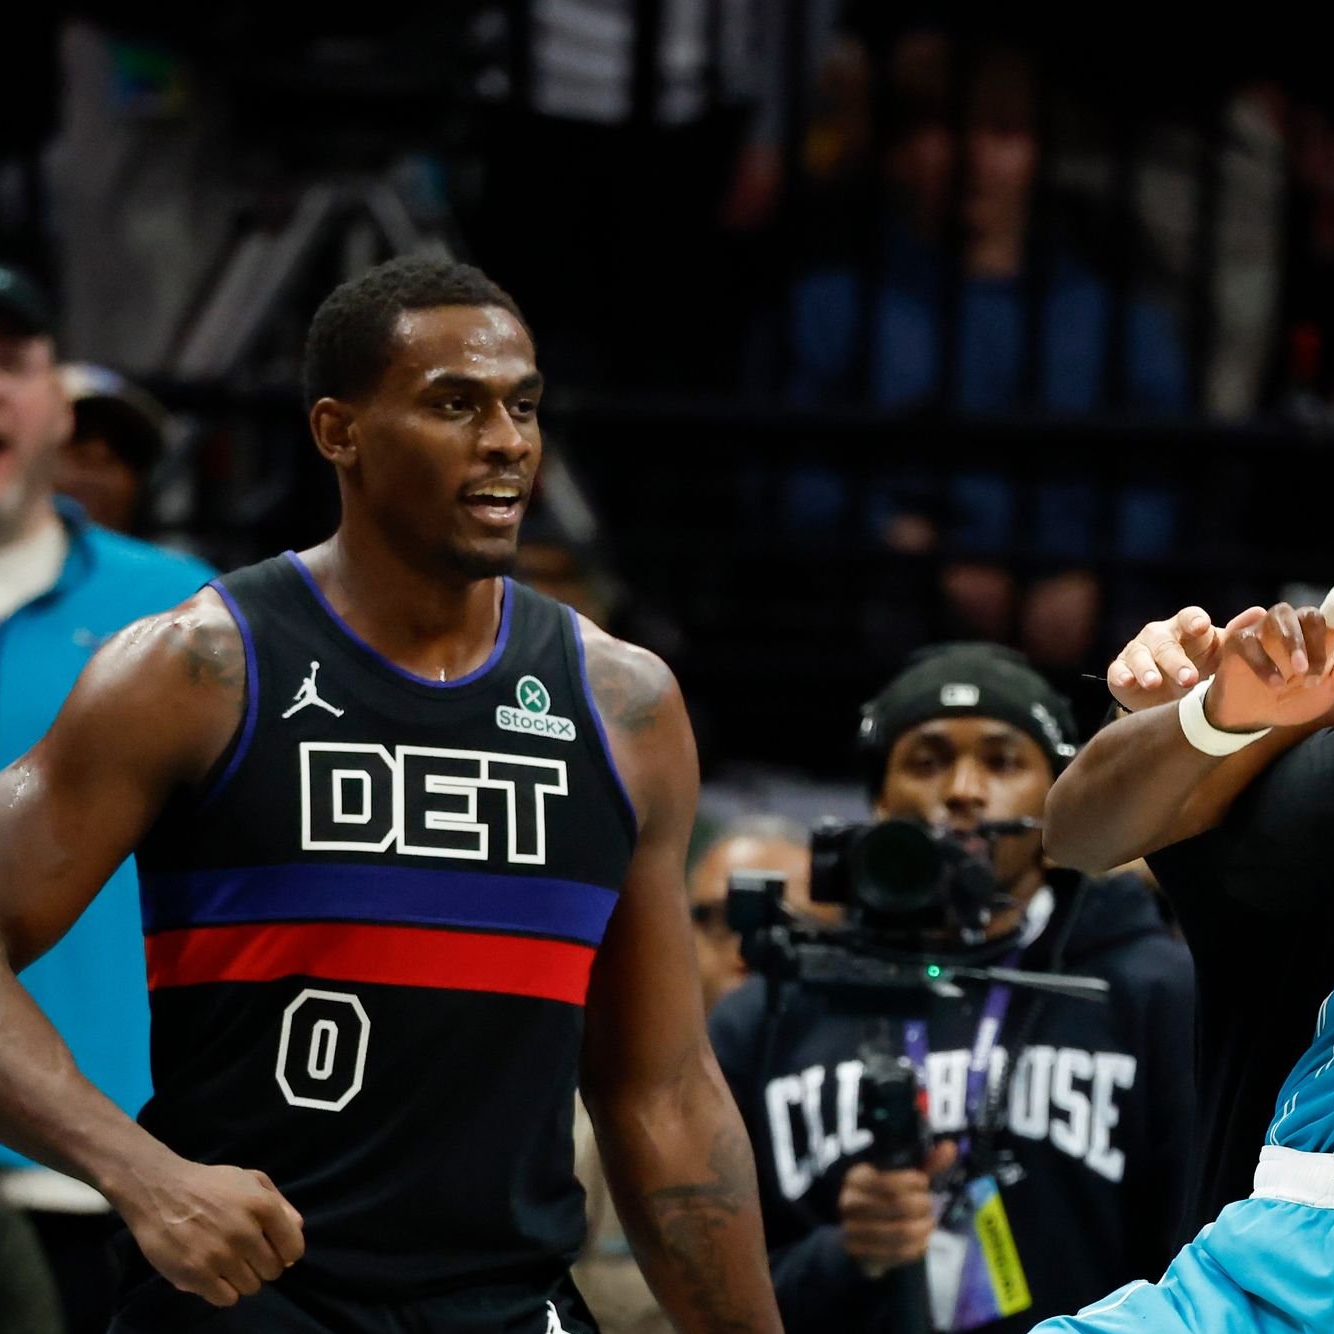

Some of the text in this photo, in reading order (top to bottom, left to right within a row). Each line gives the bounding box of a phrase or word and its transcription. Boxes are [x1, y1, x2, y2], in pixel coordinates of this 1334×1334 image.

[499, 710, 573, 737] StockX
[299, 742, 568, 865] DET
[275, 988, 371, 1112] 0
